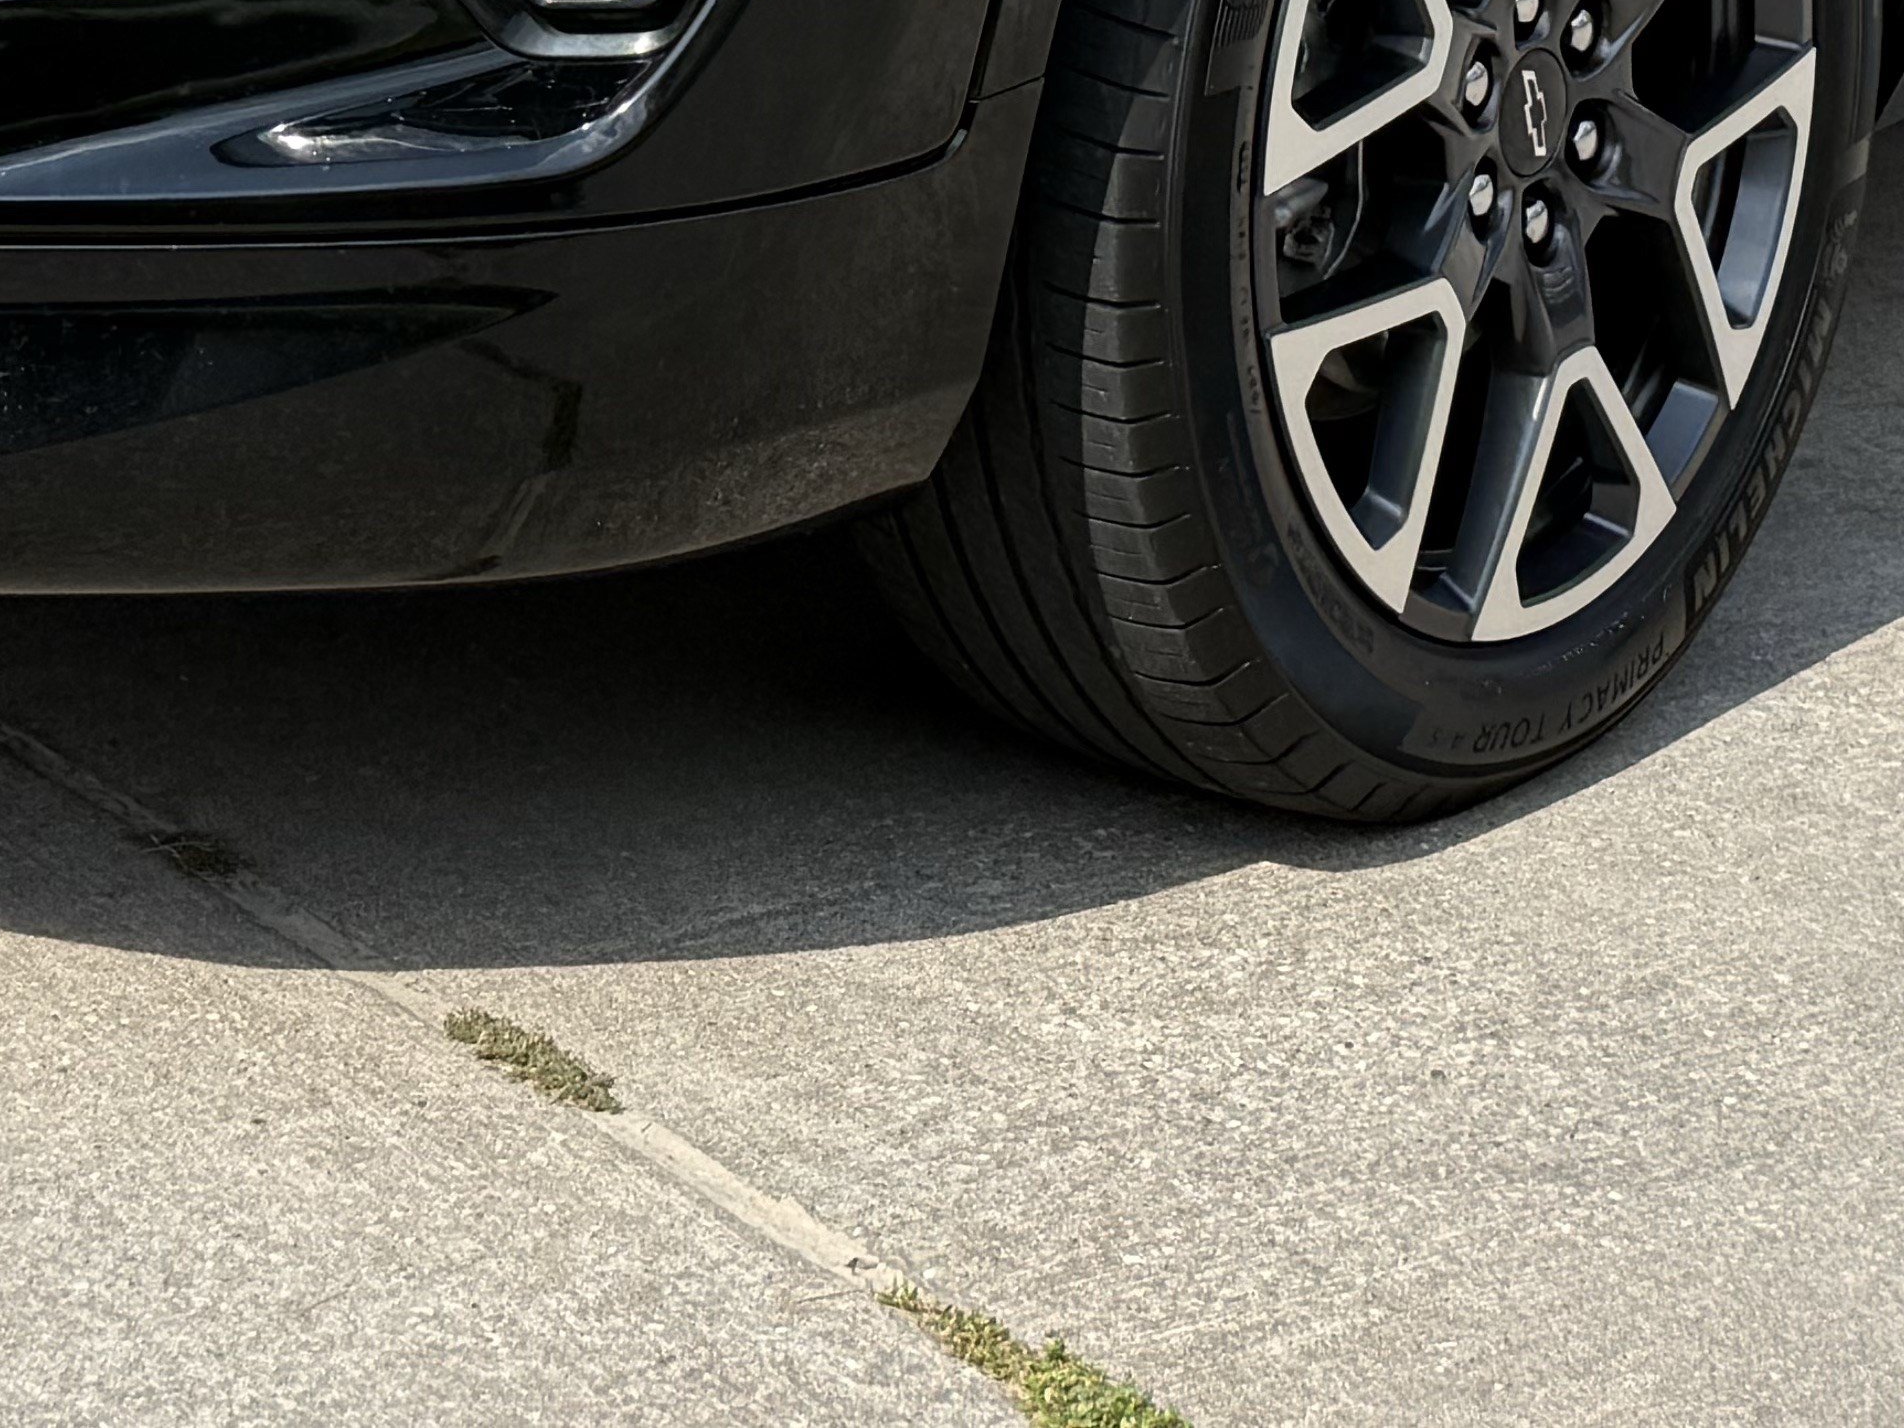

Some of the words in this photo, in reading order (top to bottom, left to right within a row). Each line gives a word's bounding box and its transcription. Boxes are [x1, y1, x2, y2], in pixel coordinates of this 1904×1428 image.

[1694, 297, 1833, 612] MICHELIN
[1472, 711, 1546, 754] TOUR
[1559, 631, 1665, 734] PRIMACY
